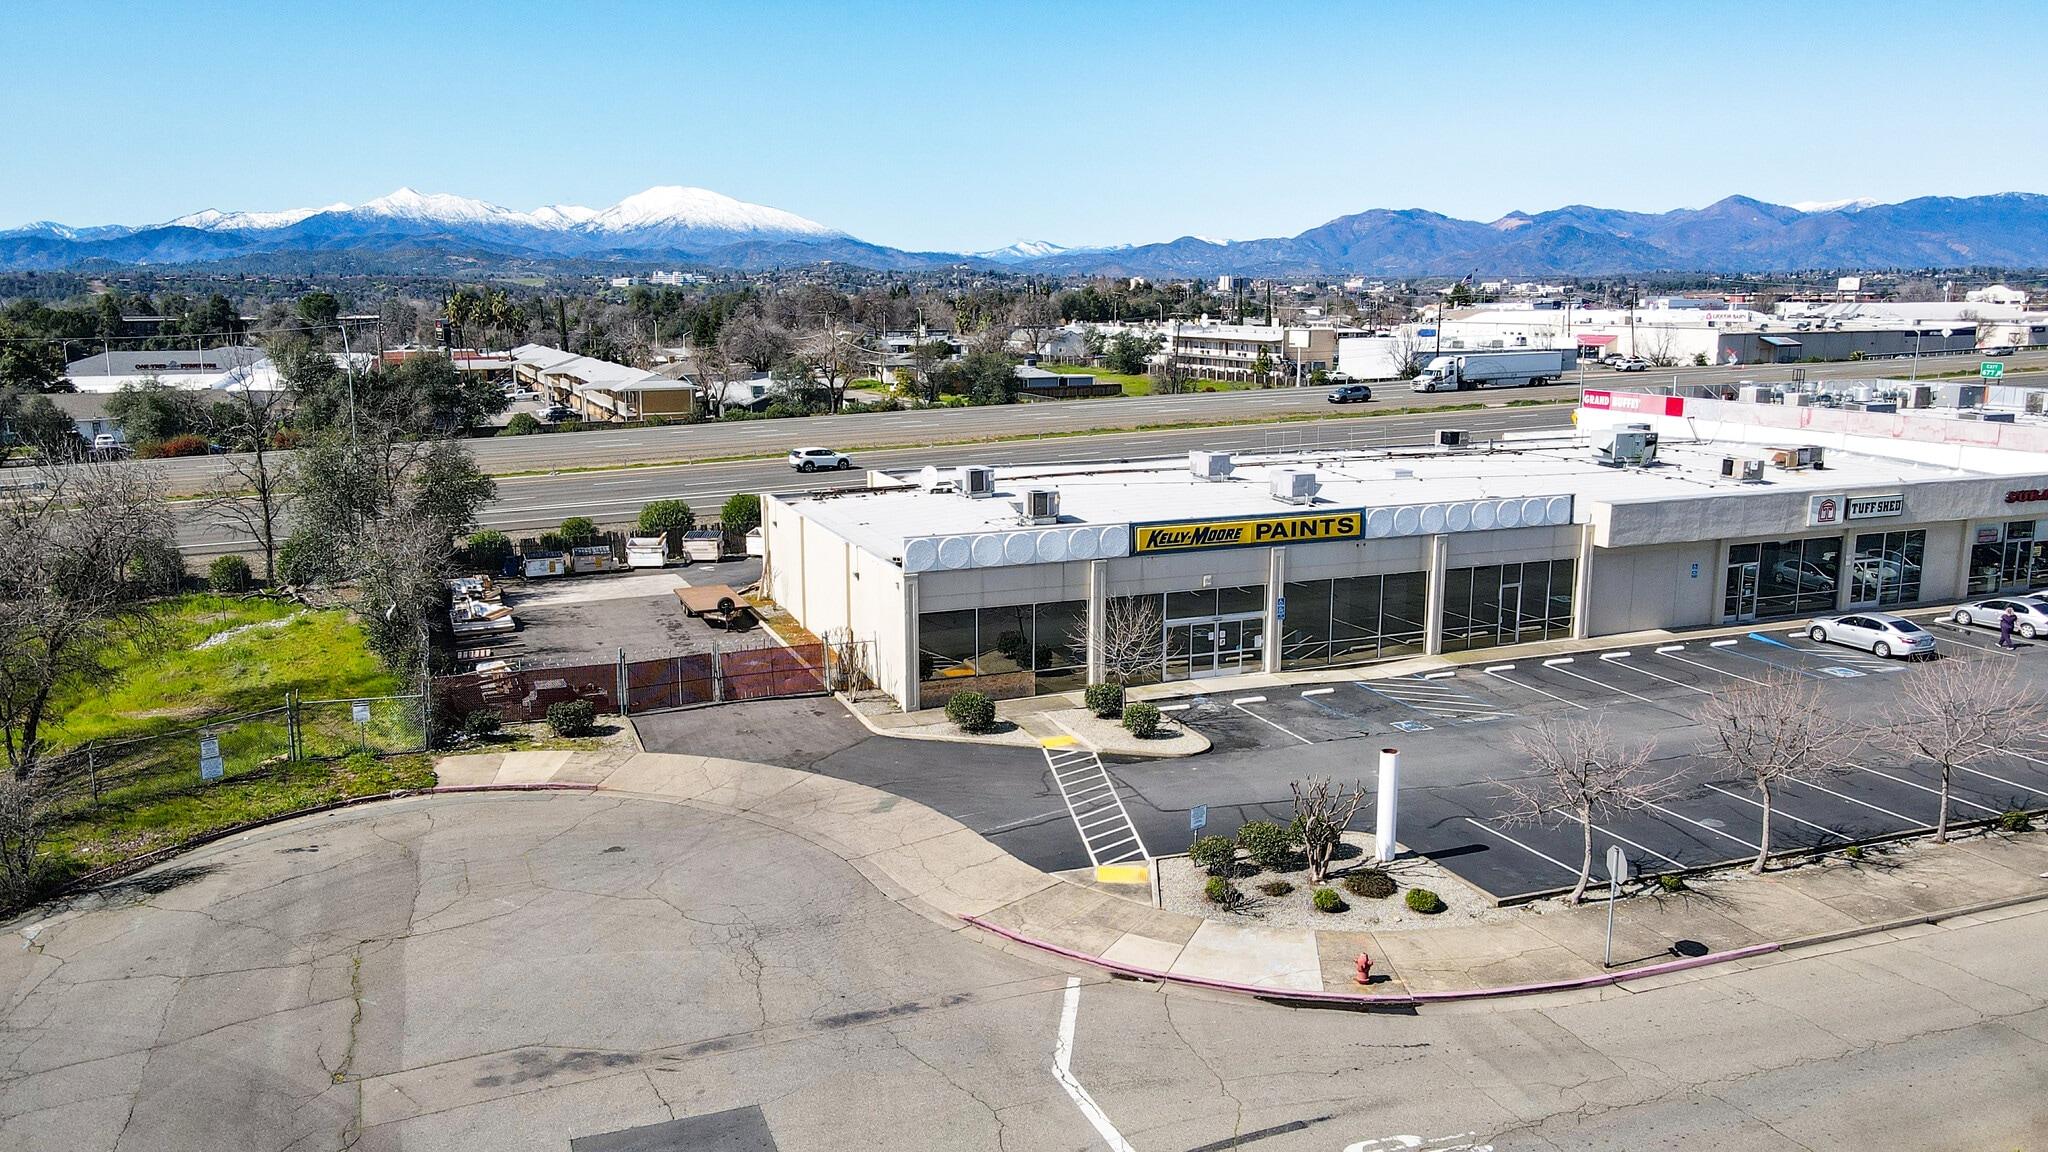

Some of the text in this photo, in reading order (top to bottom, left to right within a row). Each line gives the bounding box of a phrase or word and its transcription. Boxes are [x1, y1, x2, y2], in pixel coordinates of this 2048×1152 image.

[1584, 394, 1640, 409] GRAND BUFFET
[1851, 500, 1902, 514] TUFF SHED
[1146, 517, 1354, 549] KELLY-MOORE PAINTS
